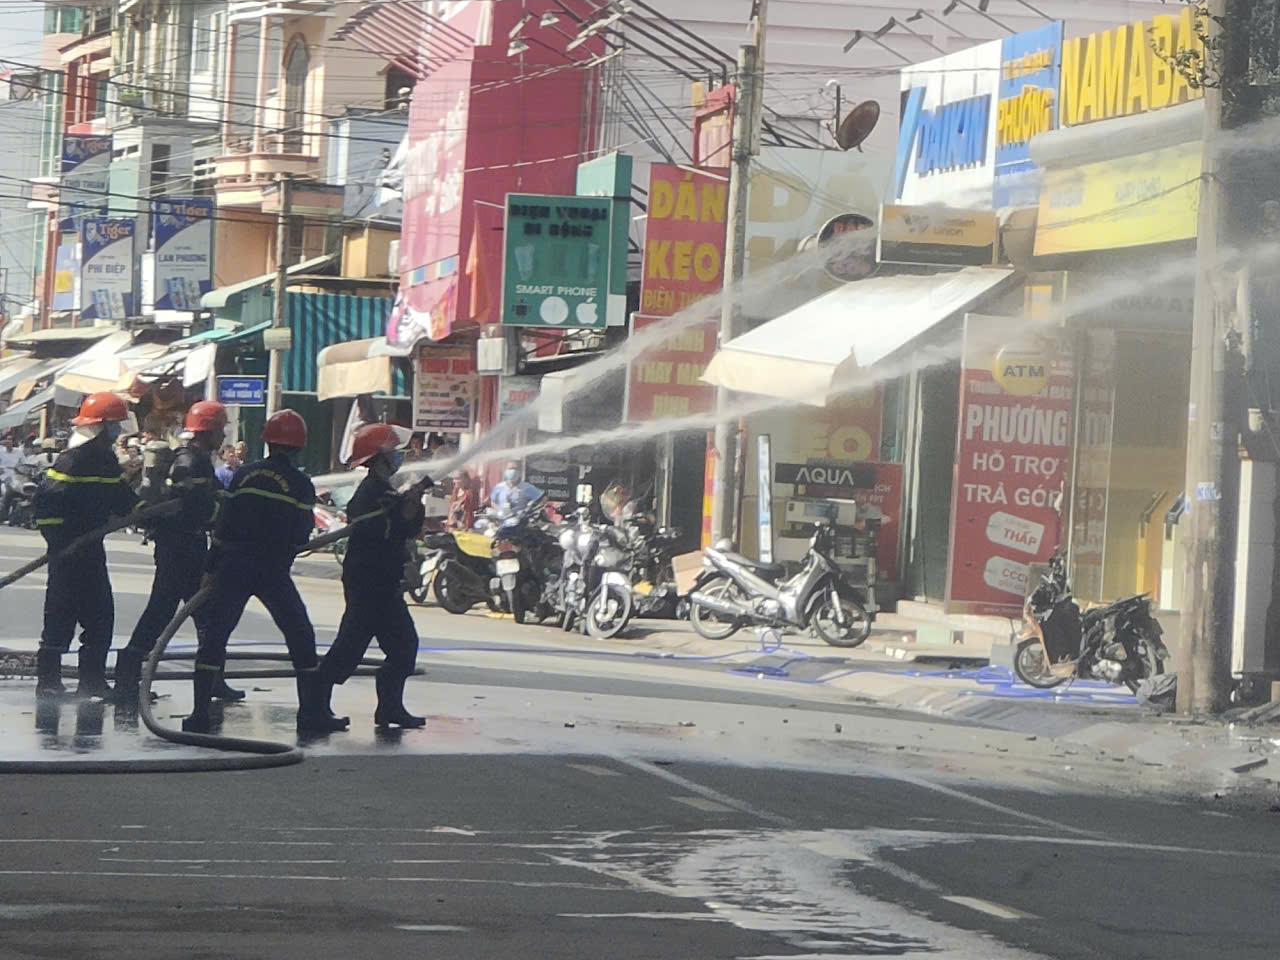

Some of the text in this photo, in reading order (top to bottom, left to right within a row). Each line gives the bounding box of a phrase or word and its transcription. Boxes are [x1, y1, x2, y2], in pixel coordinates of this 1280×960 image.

[1059, 6, 1208, 127] NAMABA
[652, 172, 725, 223] DÁN
[174, 201, 208, 221] Tiger
[100, 223, 131, 239] Tiger
[648, 240, 721, 282] KEO
[515, 284, 598, 297] SMART PHONE
[1003, 365, 1045, 377] ATM
[966, 403, 1067, 447] PHƯƠNG
[972, 449, 1060, 480] HỖ TRỢ
[795, 467, 855, 486] AQUA
[963, 481, 1008, 505] TRẢ
[1002, 568, 1029, 583] CCC
